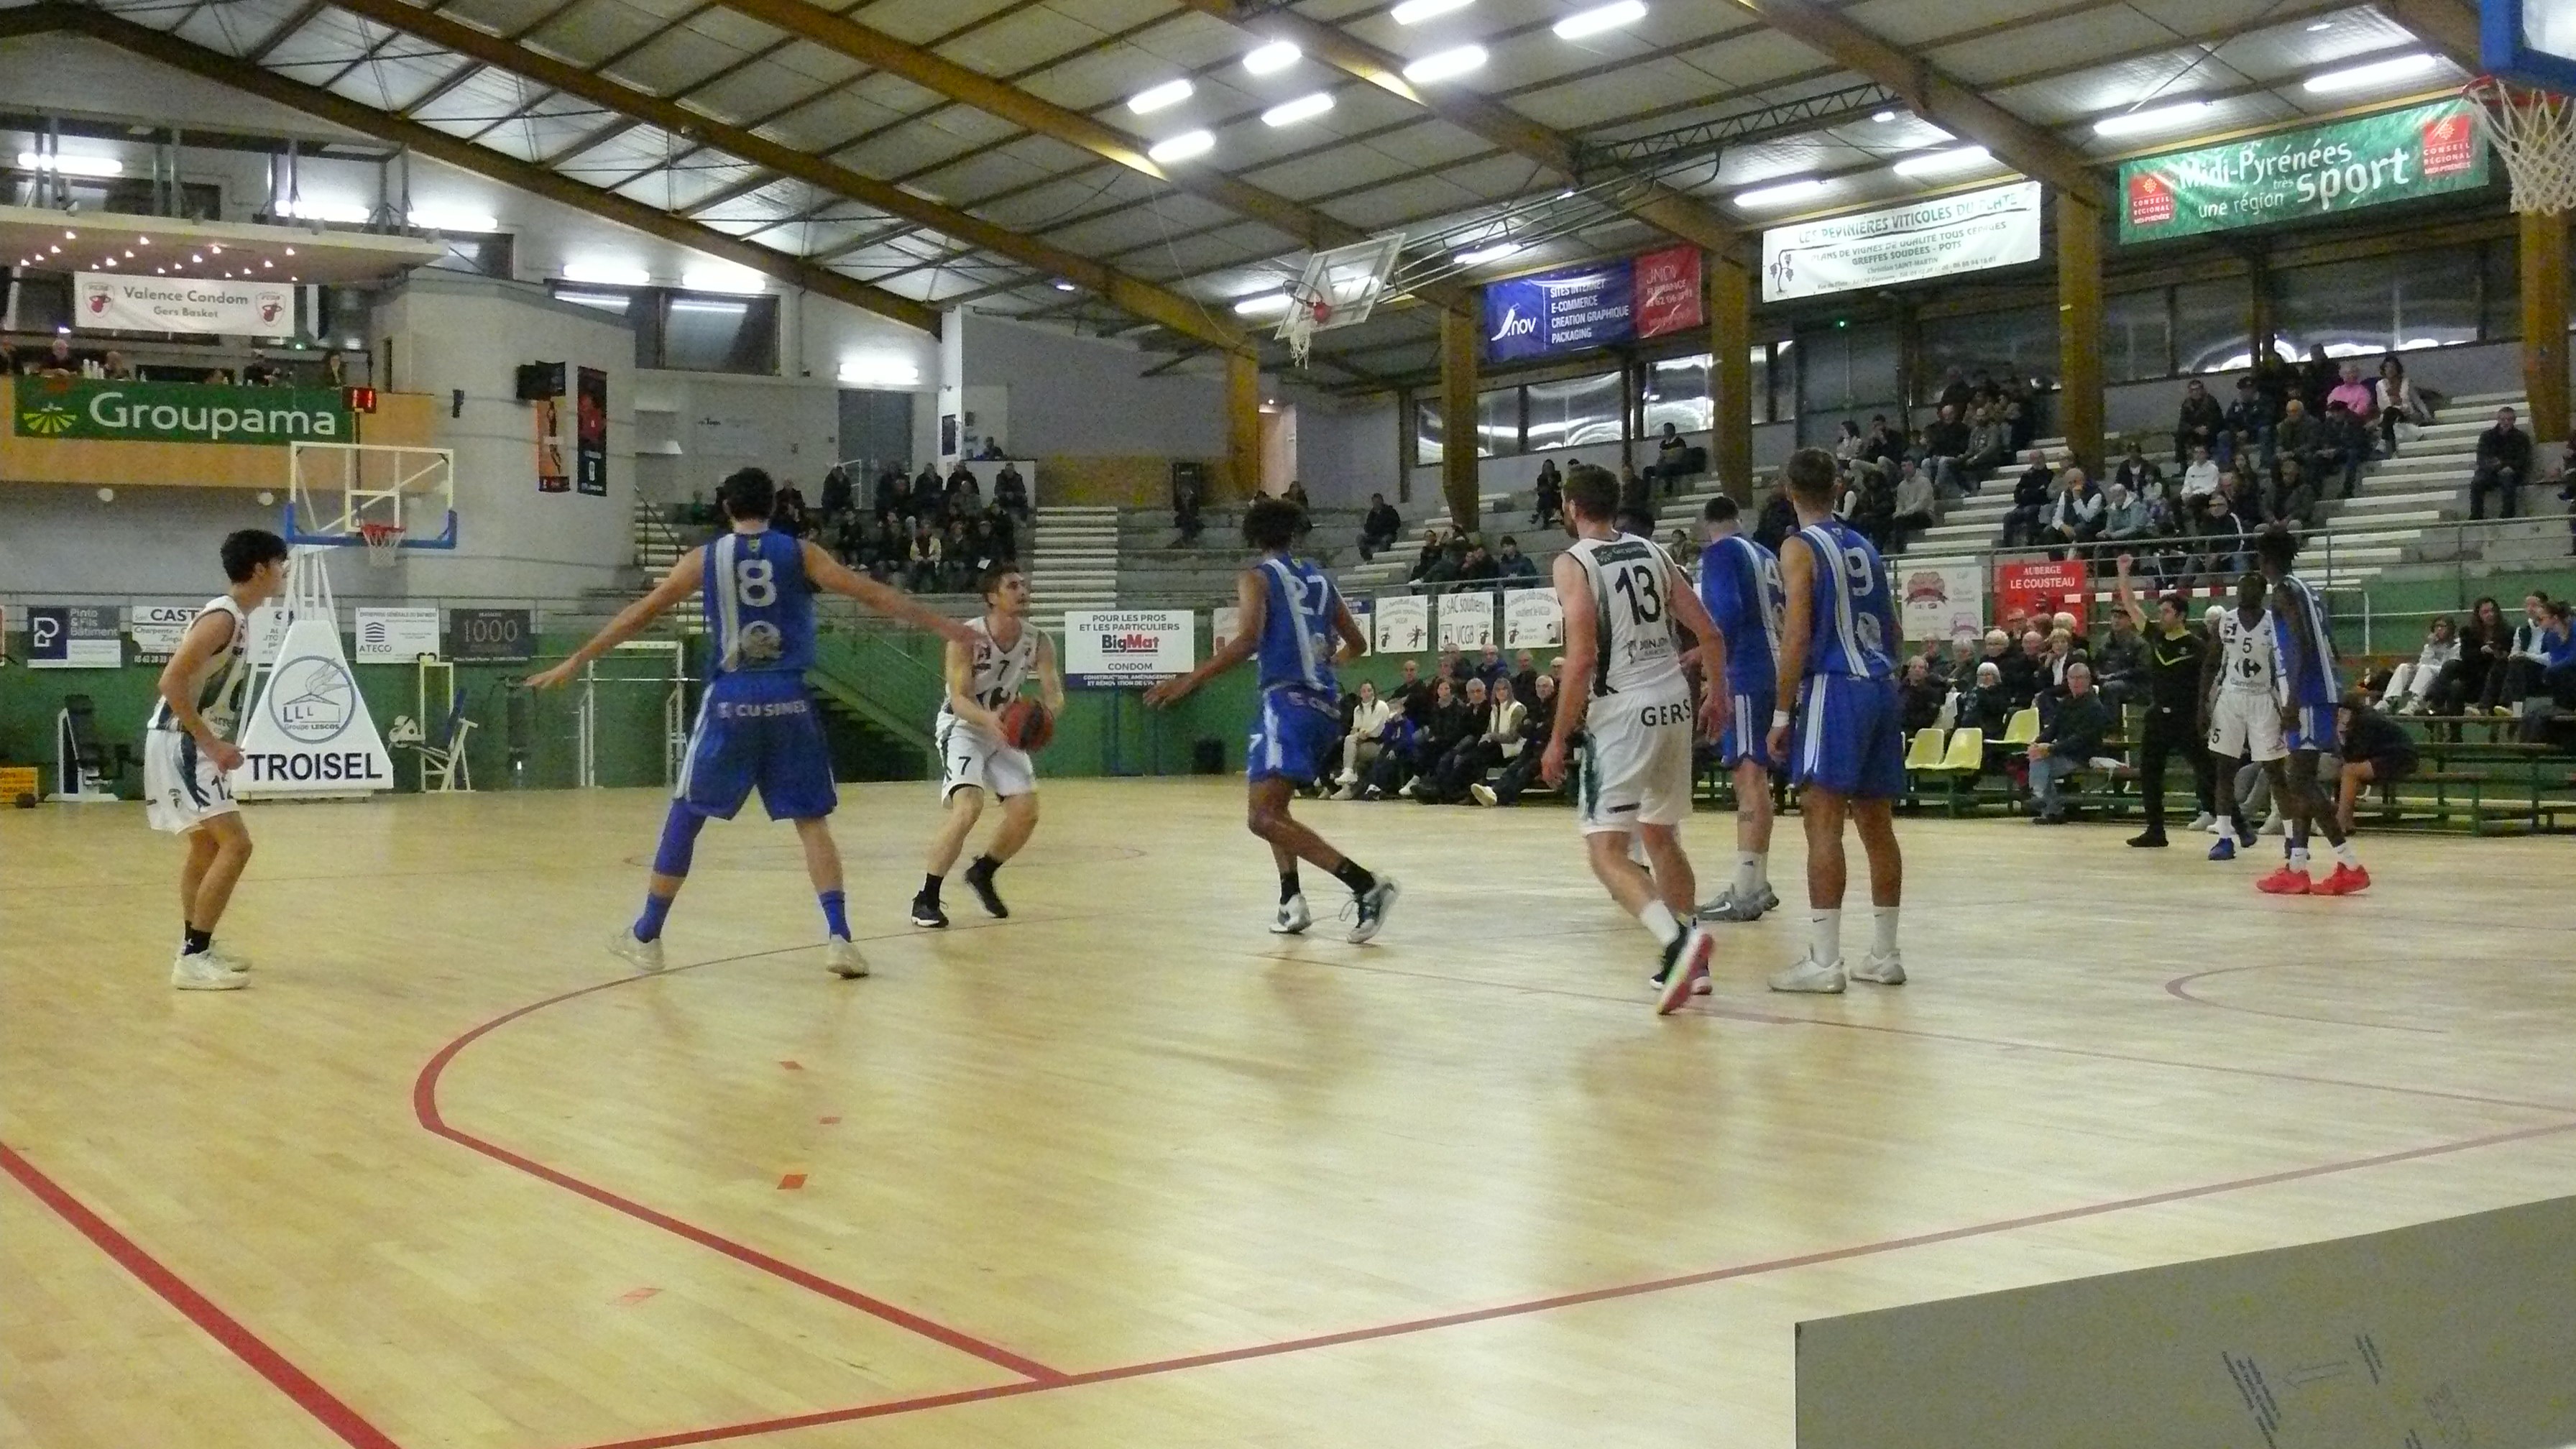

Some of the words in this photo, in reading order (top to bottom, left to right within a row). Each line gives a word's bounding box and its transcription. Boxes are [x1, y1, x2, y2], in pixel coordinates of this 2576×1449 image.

[2423, 143, 2470, 156] CONSEIL
[2198, 201, 2227, 218] une
[2234, 192, 2284, 215] région
[2273, 178, 2294, 190] très
[2296, 147, 2410, 211] sport
[2133, 196, 2169, 207] CONSEIL
[1892, 206, 1952, 229] VITICOLES
[1839, 249, 1850, 258] DE
[1852, 244, 1882, 256] VIGNES
[1940, 229, 1964, 241] TOUS
[1852, 254, 1888, 266] GREFFES
[1938, 241, 1962, 252] POTS
[123, 286, 183, 302] Valence
[186, 290, 249, 305] Condom
[1550, 286, 1570, 298] SITES
[153, 306, 178, 317] Gers
[182, 307, 218, 318] Basket
[1551, 295, 1598, 314] E-COMMERCE
[1551, 313, 1586, 328] CREATION
[1587, 305, 1630, 322] GRAPHIQUE
[1551, 327, 1593, 344] PACKAGING
[89, 391, 336, 441] Groupama
[1844, 546, 1874, 597] 9
[2023, 565, 2062, 575] AUBERGE
[737, 559, 777, 607] 8
[2010, 579, 2023, 590] LE
[2023, 577, 2076, 589] COUSTEAU
[1292, 574, 1329, 616] 27
[1615, 566, 1662, 626] 13
[70, 608, 98, 617] Pinto
[464, 619, 518, 643] 1000
[1112, 622, 1180, 631] PARTICULIERS
[359, 644, 392, 653] ATECO
[1101, 634, 1160, 653] BigMat
[2242, 638, 2253, 654] 5
[998, 659, 1011, 681] 7
[1108, 662, 1154, 671] CONDOM
[2212, 728, 2222, 745] 5
[247, 753, 382, 781] TROISEL
[958, 755, 972, 776] 7
